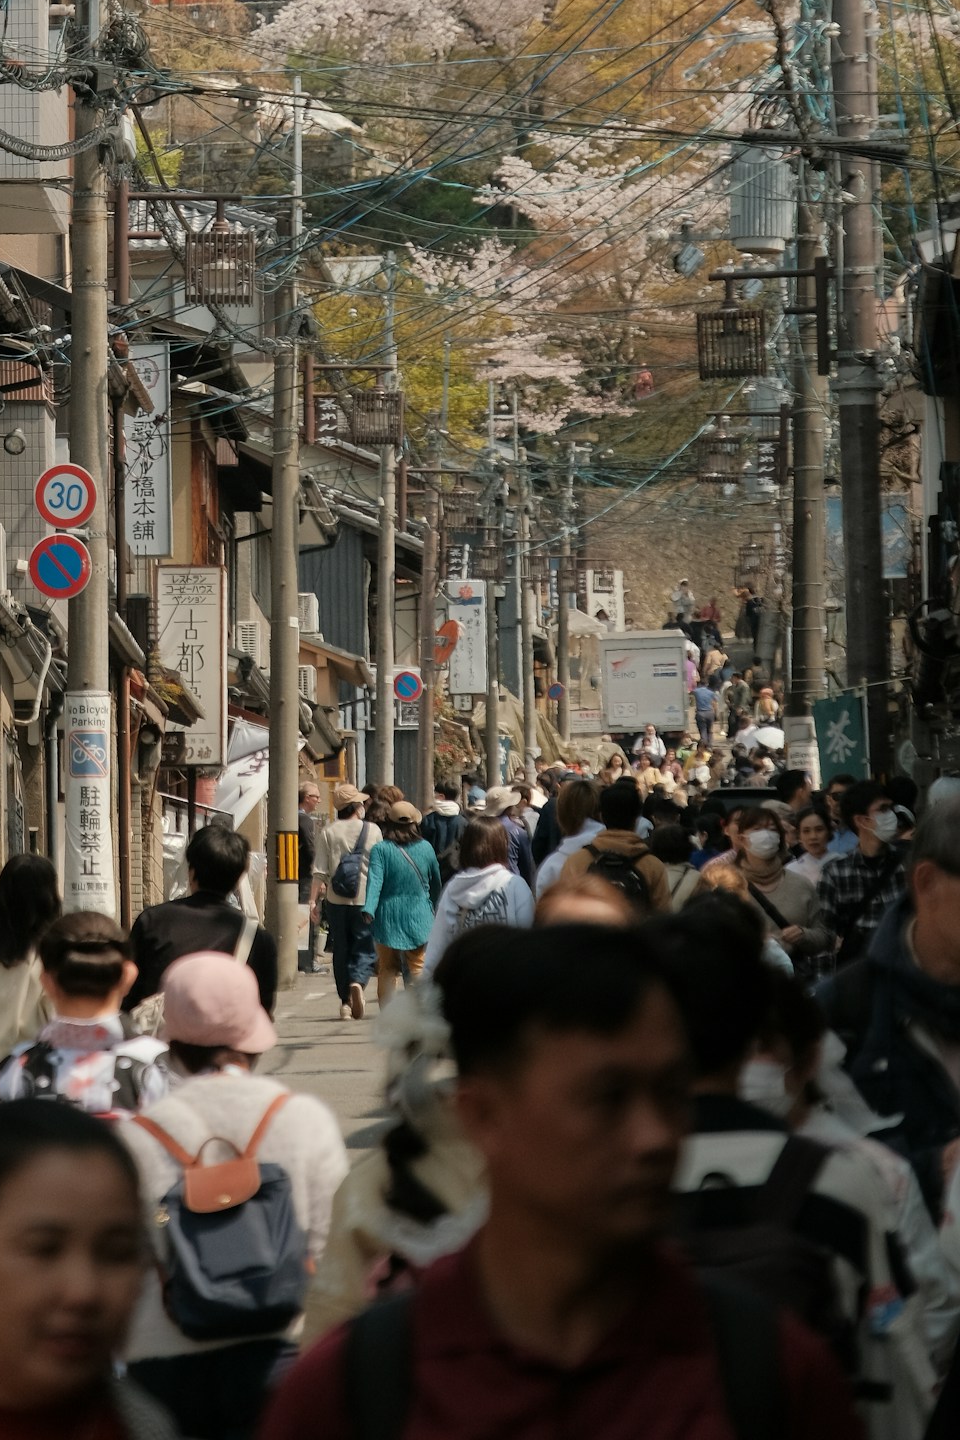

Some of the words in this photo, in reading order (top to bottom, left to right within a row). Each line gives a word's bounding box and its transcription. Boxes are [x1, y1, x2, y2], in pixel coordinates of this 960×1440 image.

[48, 481, 83, 511] 30
[172, 574, 207, 584] レストラン
[72, 717, 106, 729] Parking
[827, 710, 858, 764] 茶
[80, 786, 101, 877] 駐輪禁止
